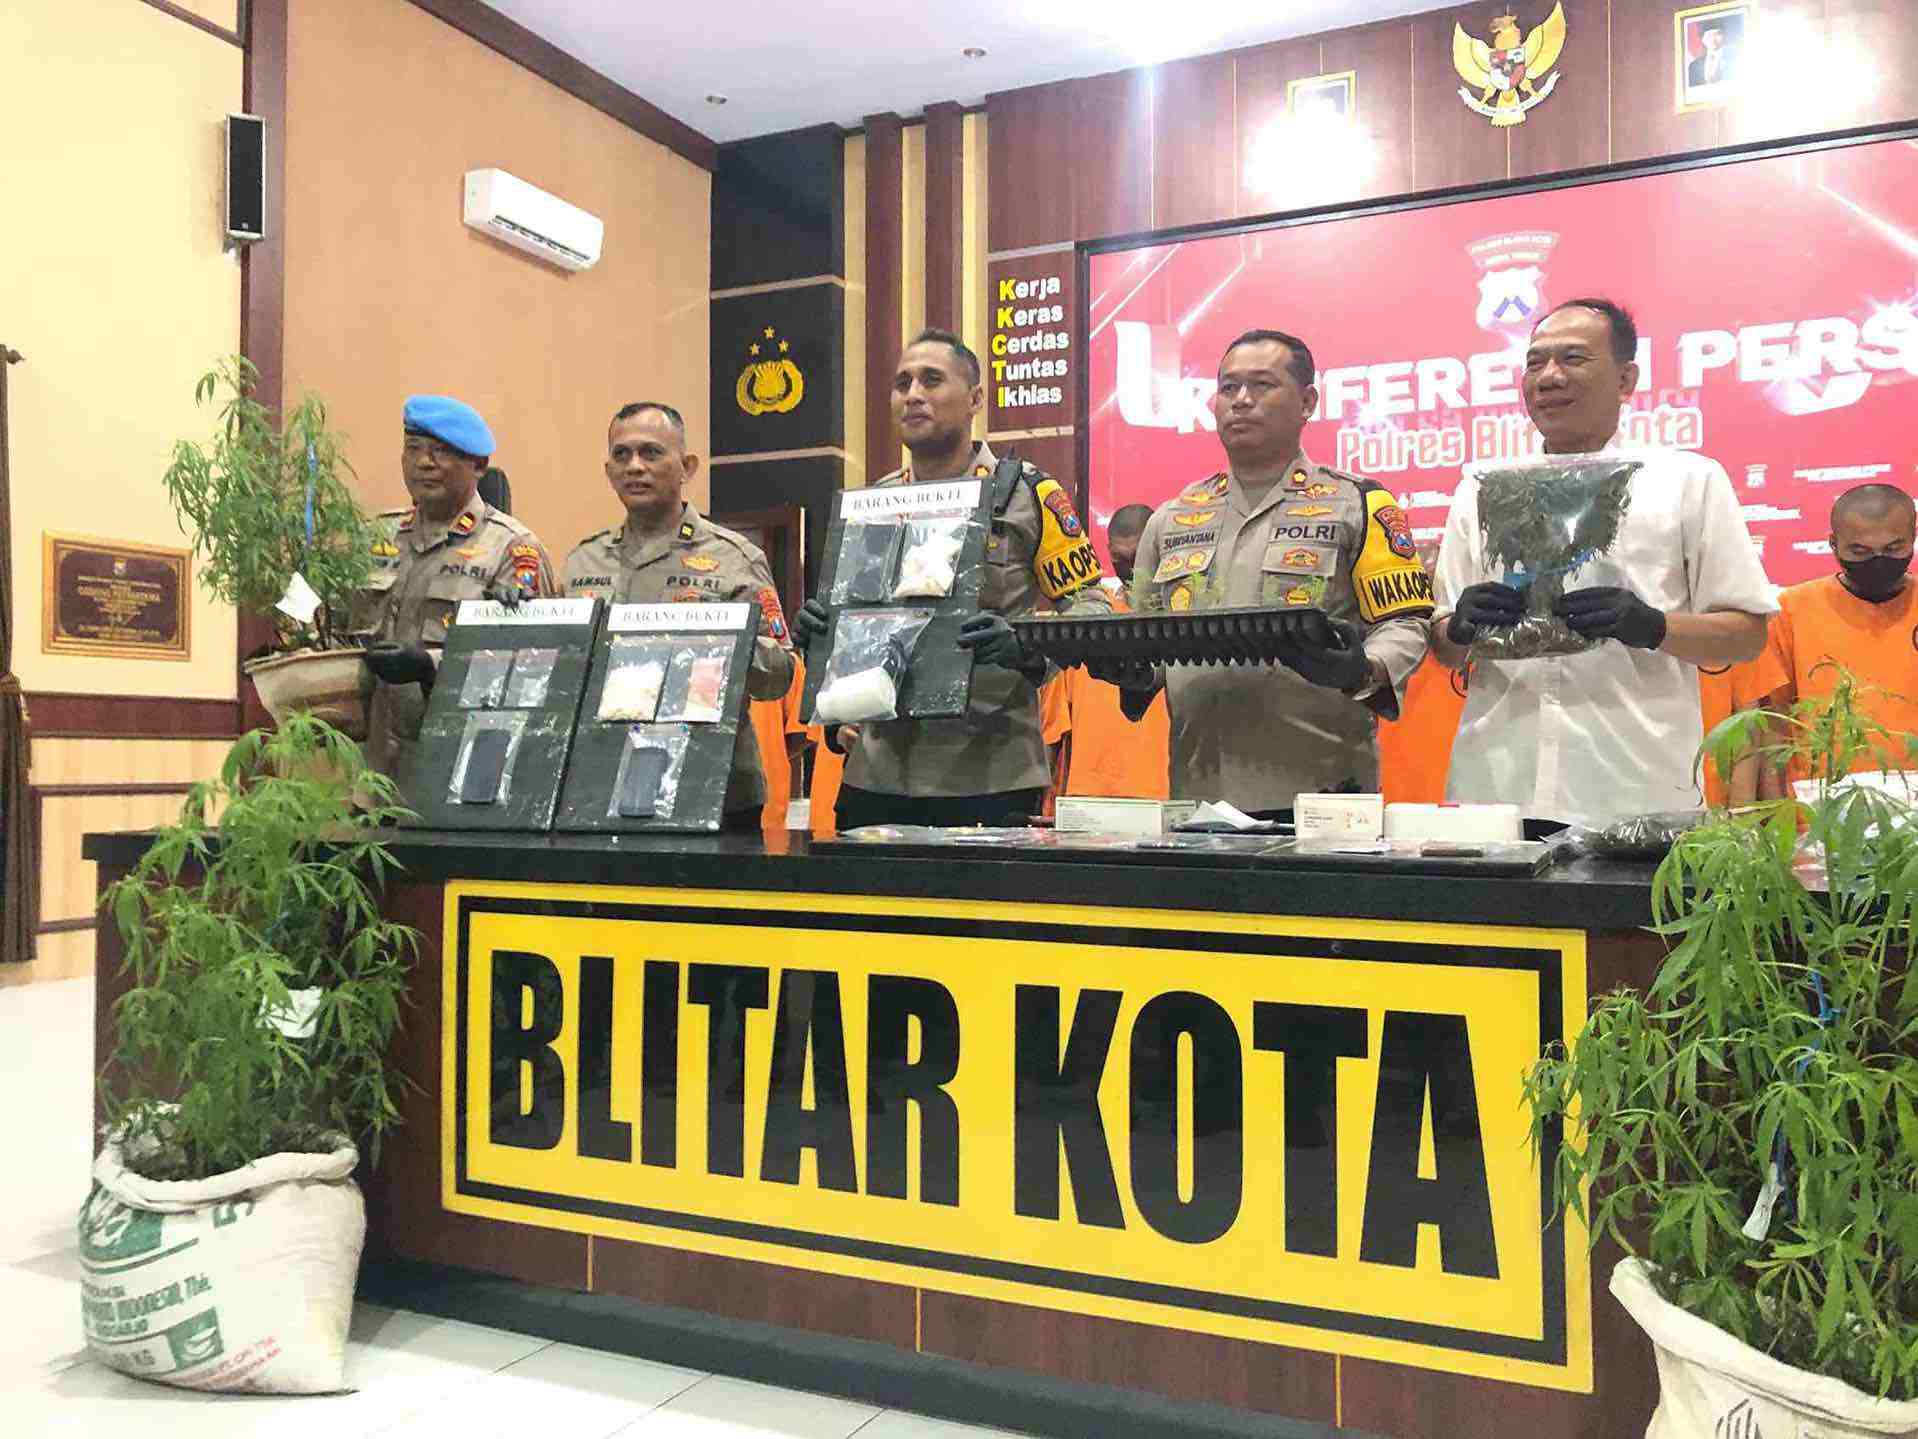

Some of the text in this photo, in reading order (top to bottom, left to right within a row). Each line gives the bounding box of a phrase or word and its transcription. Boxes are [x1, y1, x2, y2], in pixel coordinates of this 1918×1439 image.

[999, 277, 1060, 300] Kerja
[997, 305, 1063, 328] Keras
[992, 330, 1069, 355] Cerdas
[992, 358, 1068, 381] Tuntas
[998, 384, 1062, 408] Ikhlas
[1338, 425, 1464, 473] Polres
[854, 495, 912, 511] BARANG
[1275, 524, 1336, 541] POLRI
[440, 564, 487, 578] POLRI
[571, 576, 612, 588] SAMSUL
[666, 576, 720, 589] POLRI
[489, 949, 1500, 1280] BLITAR KOTA
